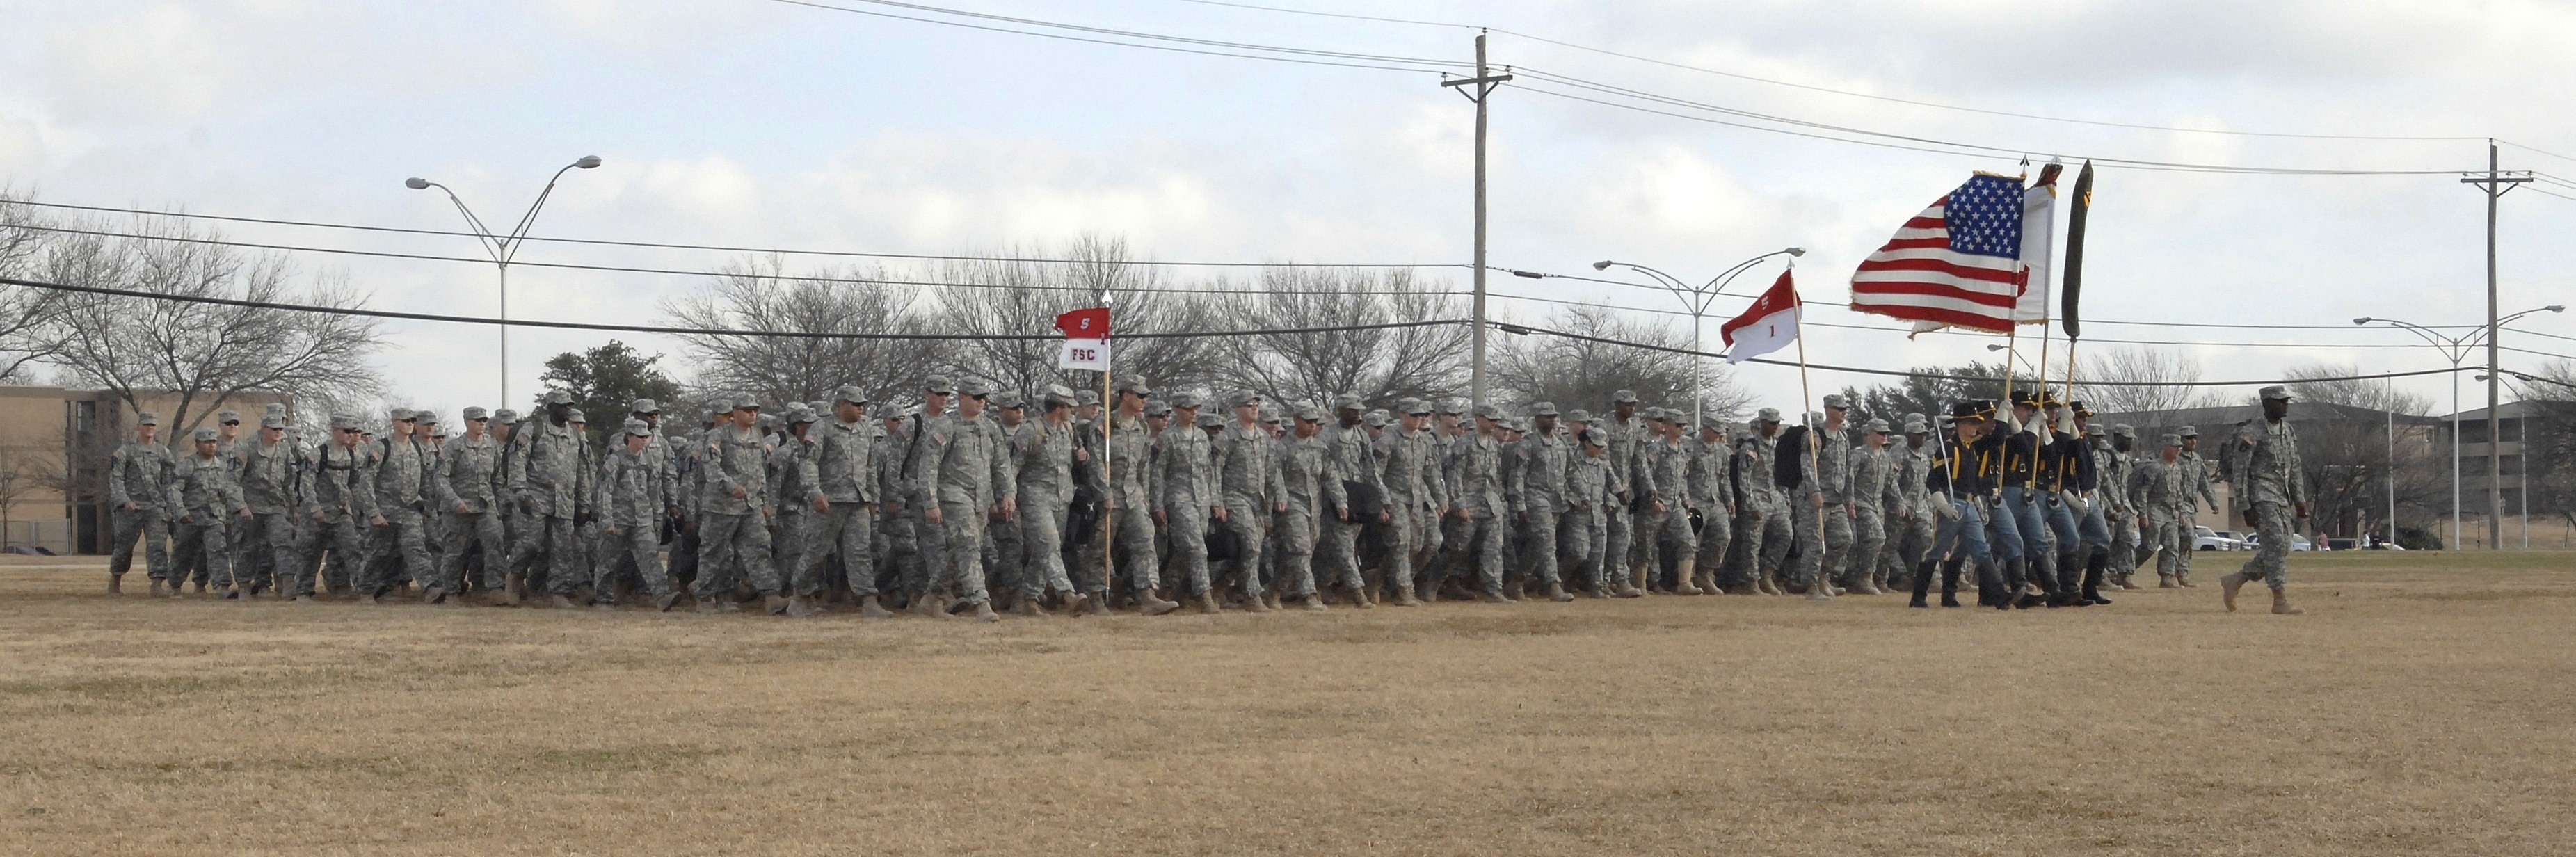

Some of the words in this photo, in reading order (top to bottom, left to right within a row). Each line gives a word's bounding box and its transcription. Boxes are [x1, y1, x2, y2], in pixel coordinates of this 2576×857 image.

[1761, 296, 1768, 310] 5
[1770, 325, 1774, 338] 1
[1073, 349, 1095, 360] FSC
